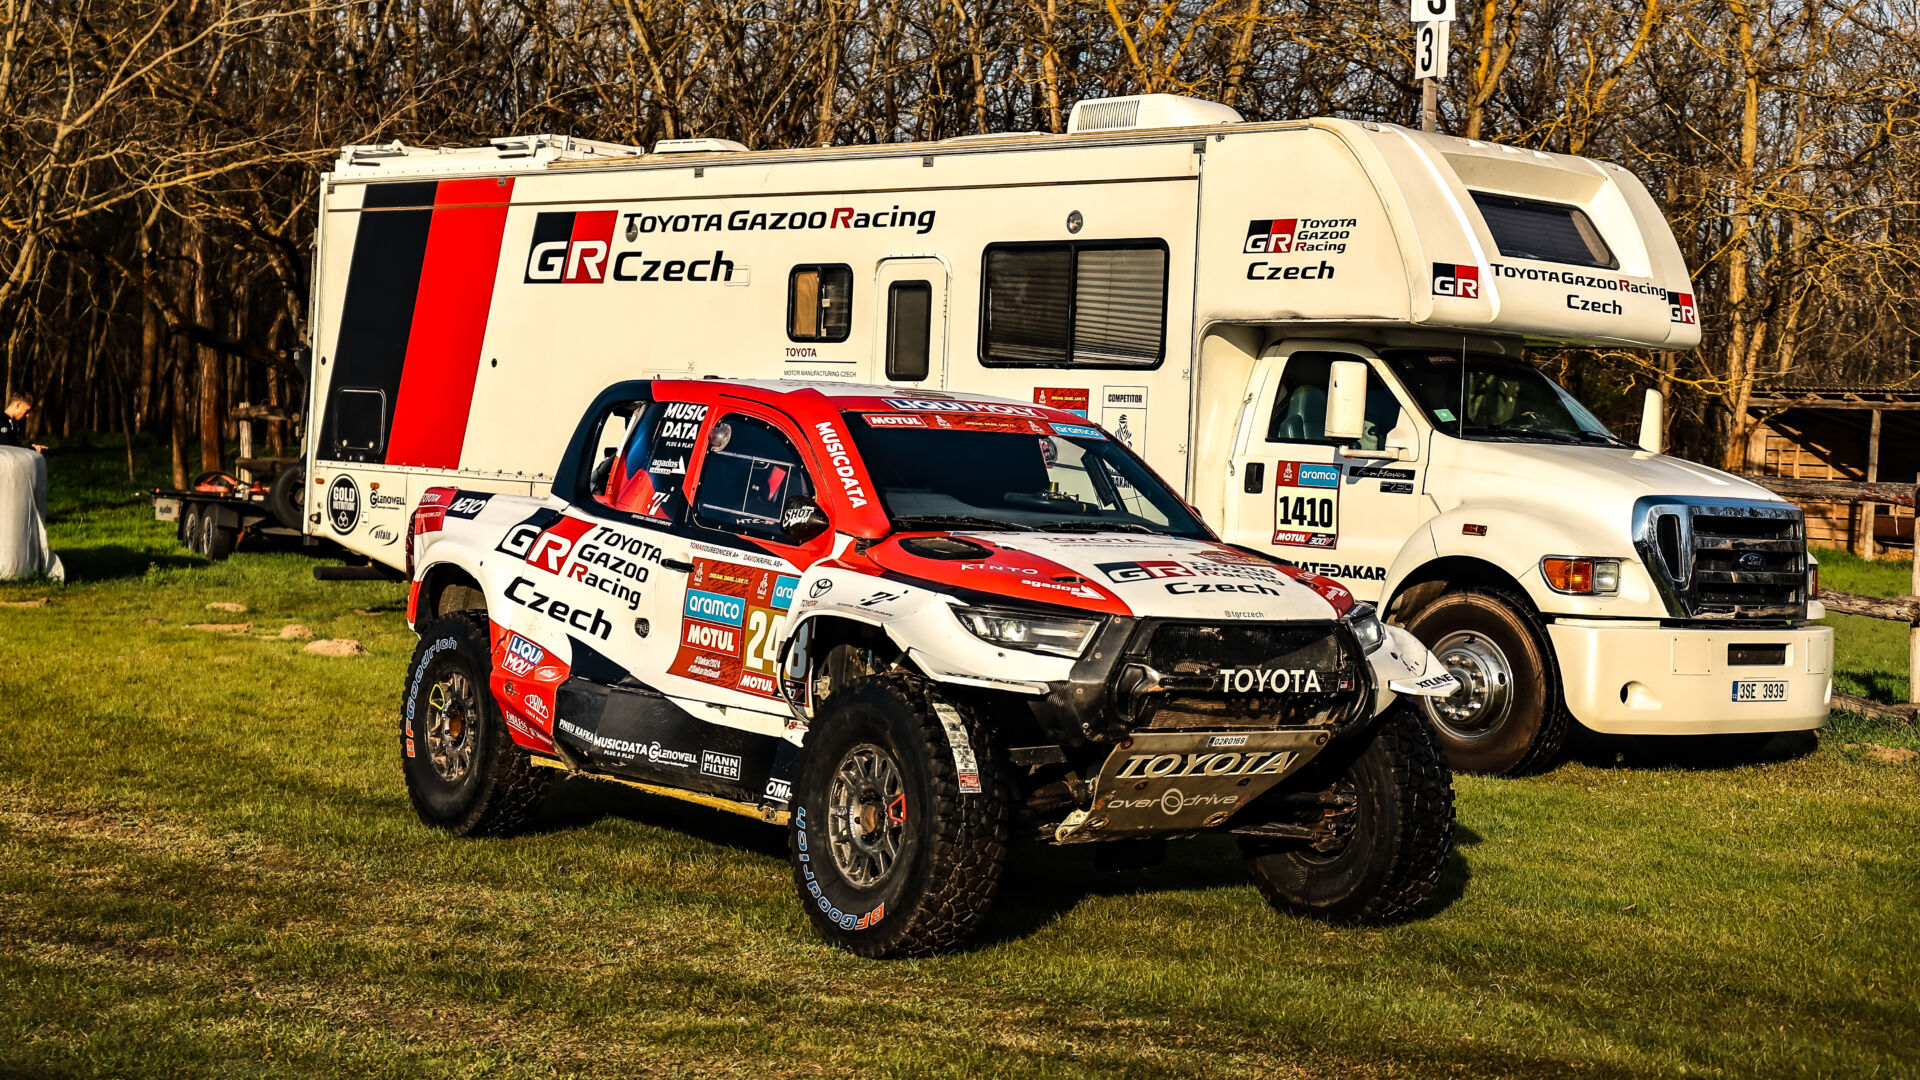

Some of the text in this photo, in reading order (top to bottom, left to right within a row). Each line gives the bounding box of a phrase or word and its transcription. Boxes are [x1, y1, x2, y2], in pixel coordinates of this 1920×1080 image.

[1421, 27, 1433, 71] 3
[623, 205, 936, 234] TOYOTA GAZOO Racing
[1300, 218, 1356, 229] TOYOTA
[1245, 233, 1293, 253] GR
[1297, 230, 1350, 240] GAZOO
[1294, 241, 1346, 254] Racing
[528, 240, 607, 280] GR
[613, 250, 734, 282] Czech
[1247, 260, 1334, 281] Czech
[1434, 276, 1479, 298] GR
[1491, 263, 1666, 300] TOYOTA GAZOO Racing
[1567, 294, 1623, 315] Czech
[1668, 304, 1695, 324] GR
[785, 347, 817, 357] TOYOTA
[891, 399, 1038, 417] LIQUI MOLY
[1108, 394, 1143, 403] COMPETITOR
[663, 402, 709, 422] MUSIC
[870, 415, 922, 426] MOTUL
[661, 421, 699, 440] DATA
[1055, 426, 1100, 437] aramco
[652, 458, 679, 468] agados
[816, 421, 868, 509] MUSICDATA
[1301, 468, 1337, 481] aramco
[333, 486, 355, 501] GOLD
[783, 508, 814, 528] SHOT
[1279, 495, 1333, 528] 1410
[593, 526, 662, 564] TOYOTA
[1276, 531, 1306, 542] MOTUL
[1309, 536, 1334, 546] 300V
[501, 524, 572, 572] GR
[577, 543, 649, 583] GAZOO
[961, 563, 1038, 575] KINTO
[1192, 565, 1276, 579] GAZOO
[1108, 566, 1192, 582] GR
[1200, 571, 1285, 586] Racing
[567, 562, 641, 611] Racing
[1021, 579, 1080, 592] agados
[1165, 581, 1281, 596] Czech
[504, 576, 612, 641] Czech
[689, 595, 740, 620] aramco
[1224, 609, 1264, 618] @tgrczech
[687, 623, 735, 652] MOTUL
[510, 635, 544, 665] LIQUI
[503, 656, 534, 676] MOLY
[740, 674, 773, 693] MOTUL
[1220, 669, 1322, 693] TOYOTA
[1739, 683, 1785, 699] 3SE 3939
[559, 718, 594, 741] PNEU KAFKA
[593, 734, 648, 756] MUSICDATA
[703, 763, 738, 777] FILTER
[705, 753, 739, 767] MANN
[1116, 751, 1300, 779] TOYOTA
